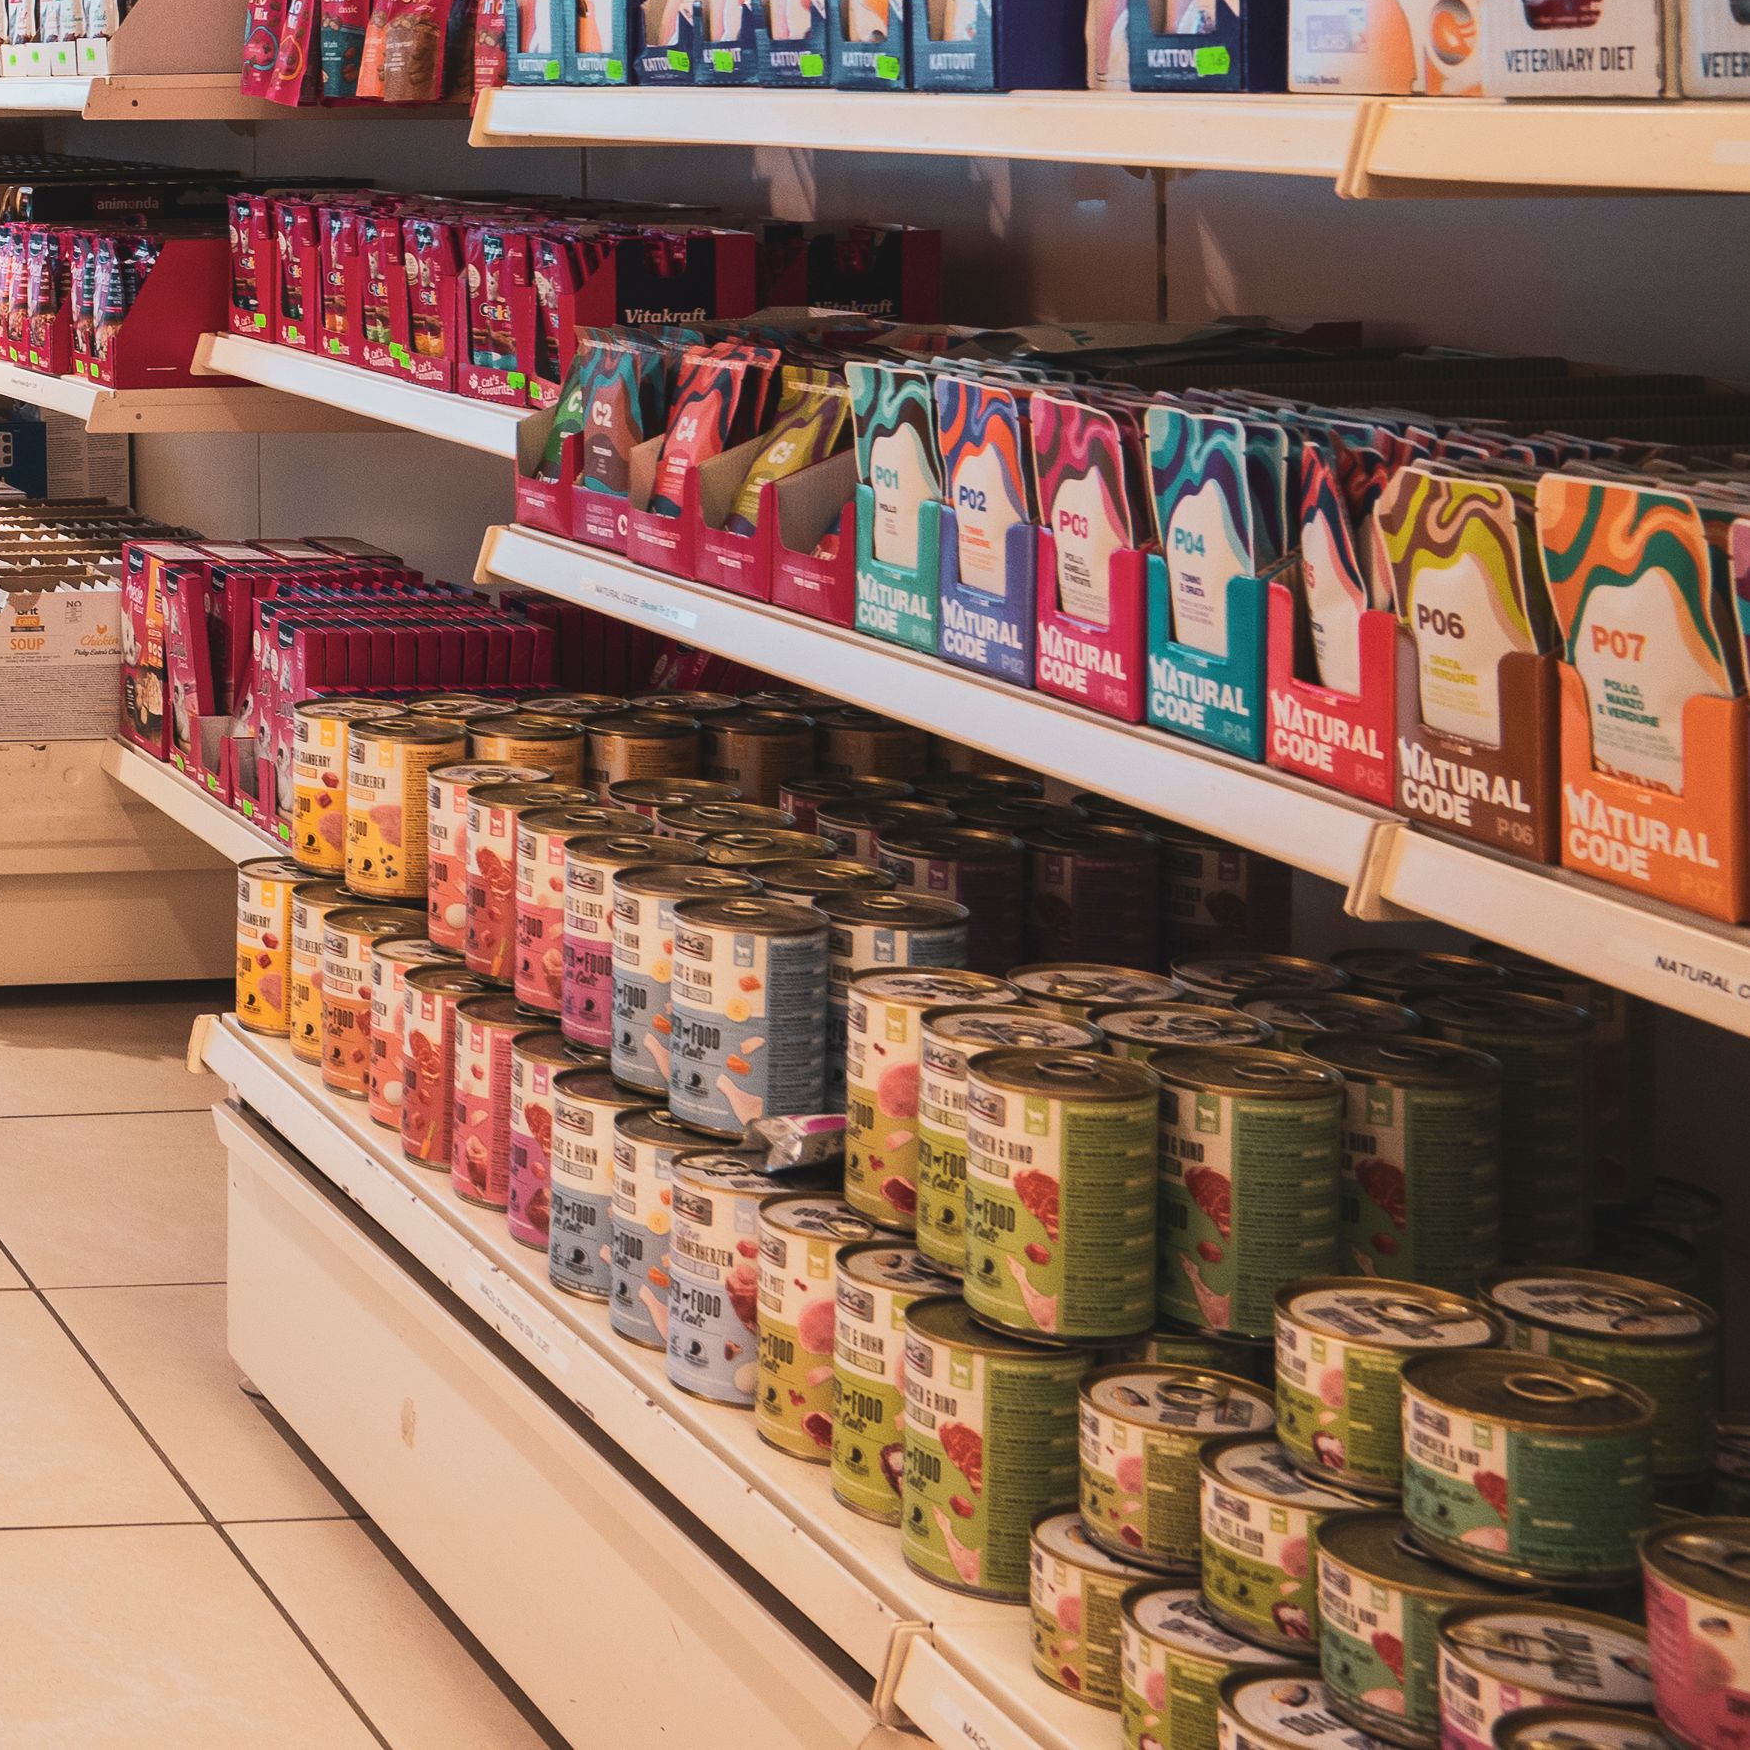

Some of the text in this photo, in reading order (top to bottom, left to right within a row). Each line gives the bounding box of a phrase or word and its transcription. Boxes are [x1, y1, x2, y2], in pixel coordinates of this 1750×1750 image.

[1505, 46, 1635, 73] VETERINARY DIET
[97, 196, 160, 212] animonda
[624, 306, 707, 325] Vitakraft
[591, 399, 613, 428] C2
[675, 416, 698, 443] C4
[874, 464, 899, 490] P01
[958, 484, 988, 514] P02
[1058, 510, 1090, 540] P03
[1173, 526, 1206, 557] P04
[66, 600, 82, 609] NO
[856, 569, 933, 621] NATURAL
[856, 605, 899, 636] CODE
[942, 595, 1023, 651] NATURAL
[1416, 602, 1466, 640] P06
[10, 637, 46, 651] SOUP
[943, 632, 988, 664] CODE
[1038, 621, 1127, 681] NATURAL
[1591, 624, 1647, 663] P07
[1039, 660, 1089, 695] CODE
[1149, 654, 1250, 717] NATURAL
[1152, 694, 1205, 731] CODE
[1270, 690, 1384, 761] NATURAL
[1271, 728, 1334, 774] CODE
[1399, 735, 1531, 814] NATURAL
[1402, 777, 1473, 828] CODE
[1497, 817, 1536, 847] P06
[1565, 784, 1720, 869] NATURAL
[1569, 829, 1651, 882] CODE
[1655, 954, 1732, 994] NATURAL
[691, 1024, 721, 1050] FOOD
[983, 1198, 1016, 1233] FOOD
[691, 1286, 722, 1319] FOOD
[851, 1390, 884, 1424] FOOD
